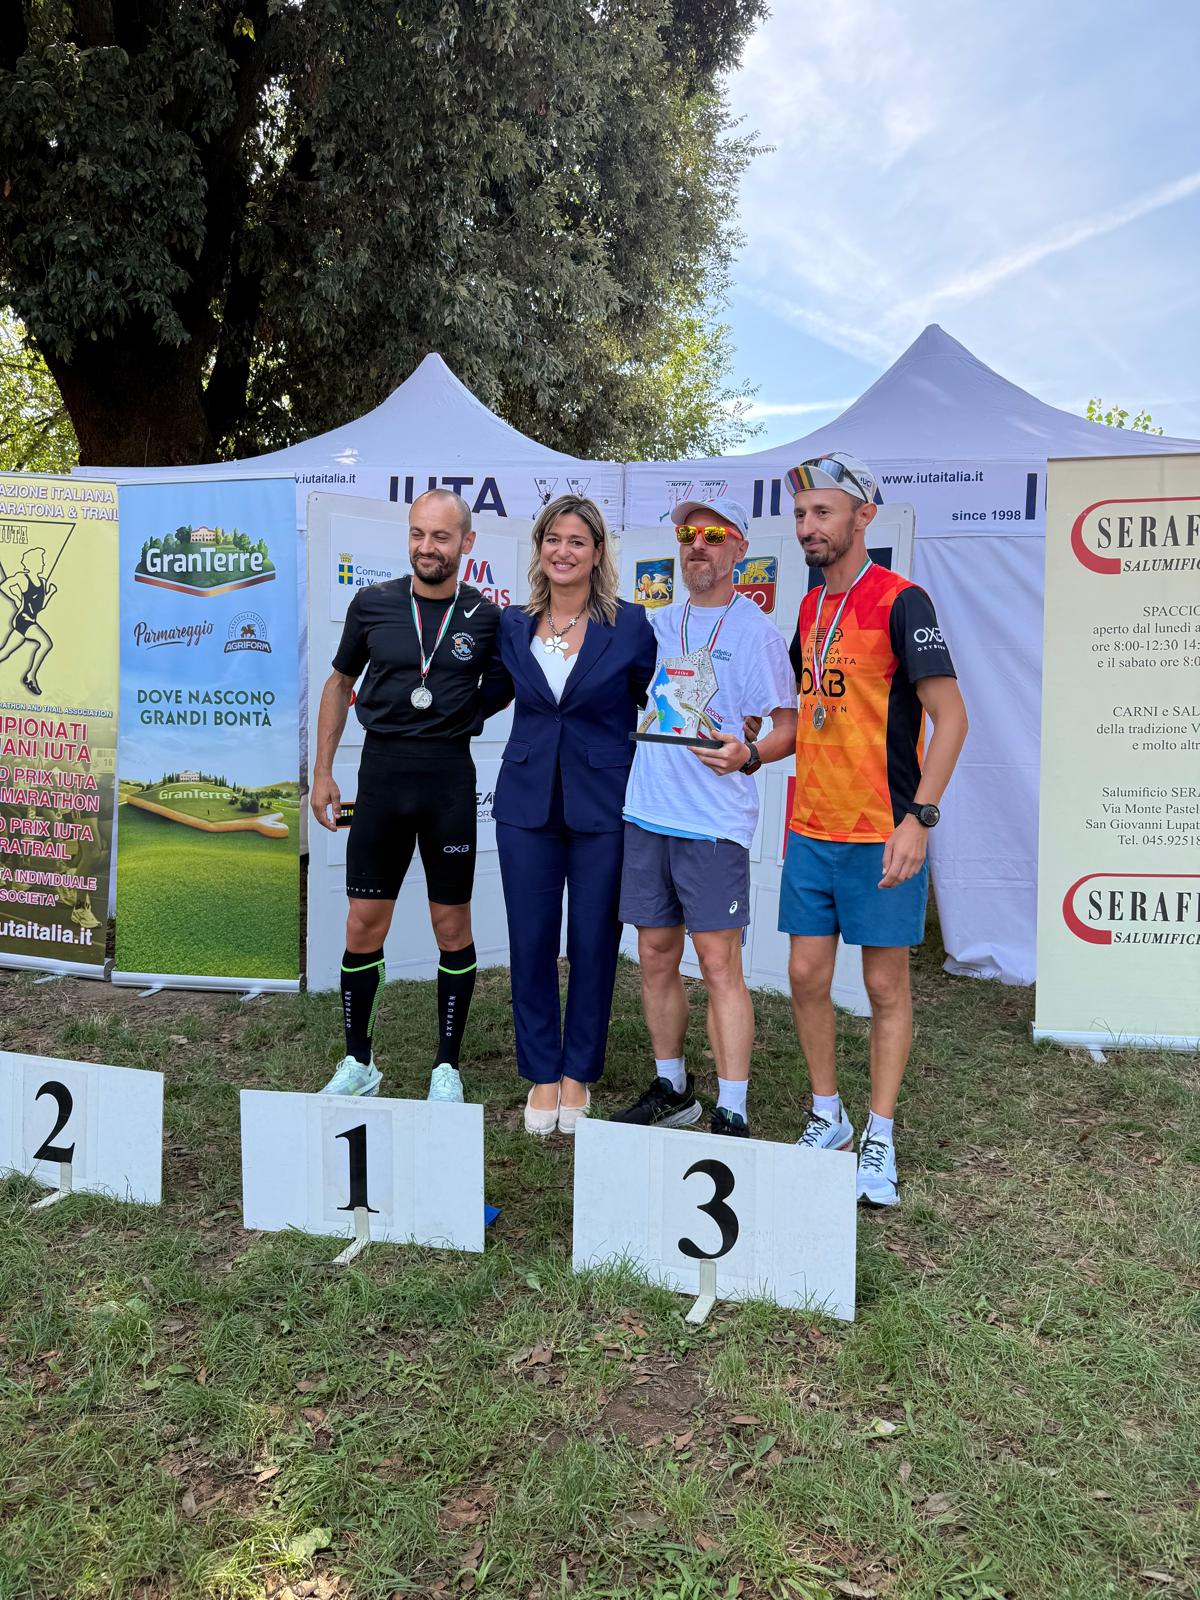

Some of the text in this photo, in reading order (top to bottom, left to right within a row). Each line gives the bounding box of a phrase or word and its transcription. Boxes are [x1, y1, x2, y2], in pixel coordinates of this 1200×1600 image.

[882, 470, 984, 484] www.iutaitalia.it
[51, 487, 114, 503] ITALIANA
[68, 506, 77, 518] &
[81, 506, 118, 521] TRAIL
[952, 510, 1021, 521] since 1998
[1097, 514, 1200, 549] SERAF
[146, 547, 264, 573] GranTerre
[355, 565, 392, 578] Comune
[356, 577, 364, 586] di
[133, 620, 214, 647] Parmareggio
[1092, 625, 1129, 637] aperto
[1132, 623, 1150, 634] dal
[1155, 622, 1191, 633] lunedi
[226, 641, 270, 652] AGRIFORM
[1091, 643, 1111, 652] ore
[1114, 640, 1178, 651] 8:00-12:30
[1097, 659, 1104, 668] e
[1107, 657, 1115, 668] il
[1119, 657, 1156, 668] sabato
[1160, 659, 1180, 667] ore
[137, 690, 275, 705] DOVE NASCONO
[27, 704, 42, 712] AND
[44, 706, 63, 714] TRAIL
[64, 708, 113, 718] ASSOCIATION
[140, 708, 272, 727] GRANDI BONTÀ
[1113, 706, 1158, 717] CARNI
[1162, 708, 1169, 716] e
[1096, 723, 1125, 734] della
[1128, 723, 1188, 734] tradizione
[44, 741, 91, 763] IUTA
[1132, 742, 1139, 750] e
[1142, 740, 1177, 750] molto
[14, 768, 54, 786] PRIX
[58, 772, 97, 790] IUTA
[0, 787, 100, 812] MARATHON
[160, 789, 231, 800] GranTerre
[1102, 787, 1200, 798] Salumificio SER
[1102, 803, 1121, 814] Via
[1125, 803, 1162, 814] Monte
[10, 818, 49, 838] PRIX
[54, 822, 93, 842] IUTA
[1085, 819, 1106, 829] San
[1110, 819, 1162, 830] Giovanni
[1117, 834, 1138, 845] Tel.
[15, 869, 97, 890] INDIVIDUALE
[344, 990, 352, 1029] OXYBURN
[445, 995, 456, 1037] OXYBURN
[33, 1080, 75, 1163] 2
[334, 1123, 380, 1214] 1
[677, 1158, 740, 1260] 3
